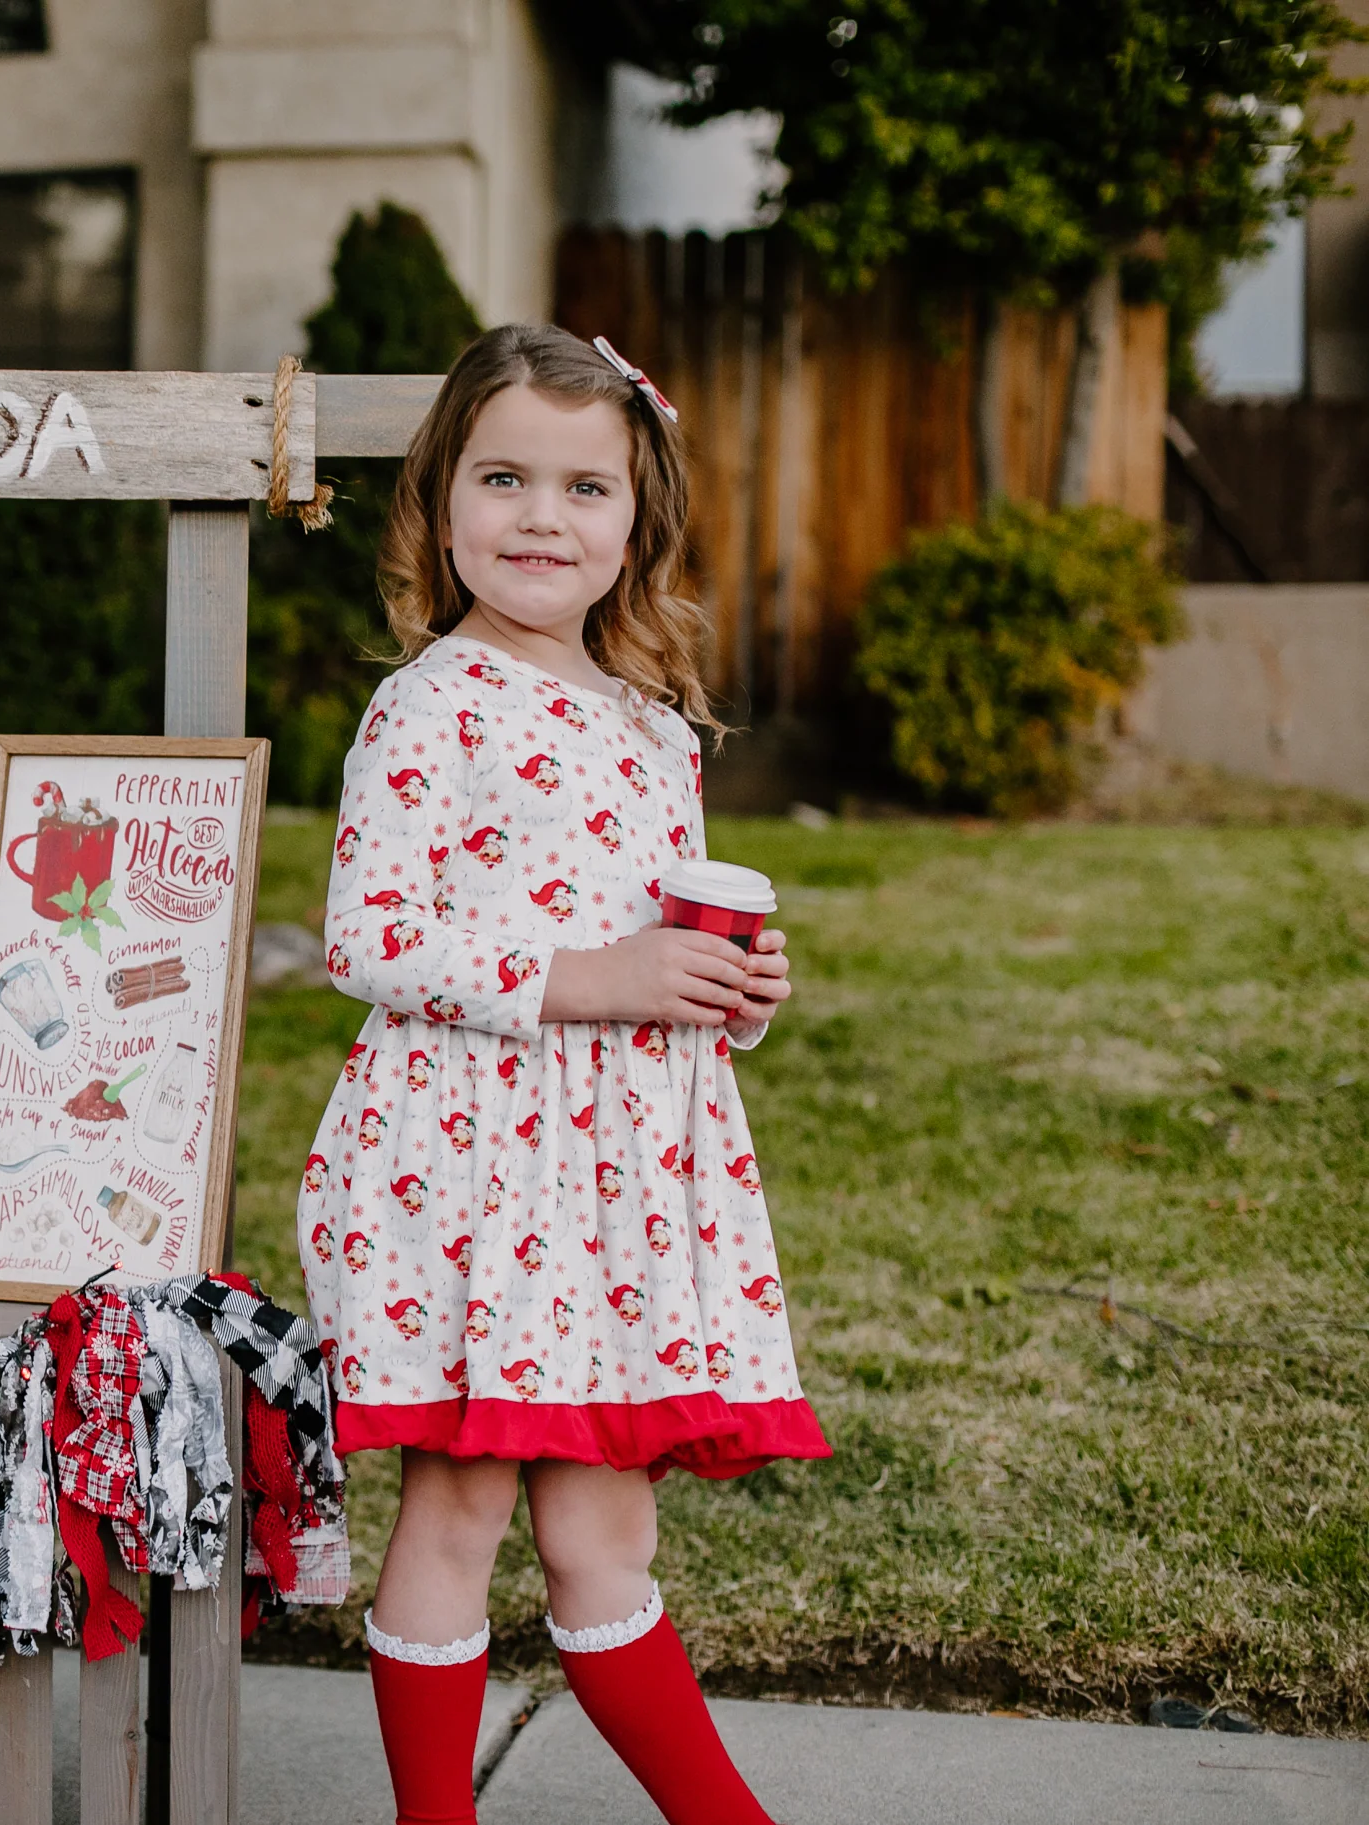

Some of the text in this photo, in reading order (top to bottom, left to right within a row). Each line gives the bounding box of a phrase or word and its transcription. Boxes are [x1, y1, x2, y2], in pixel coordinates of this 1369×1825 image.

[115, 773, 242, 807] PEPPERMINT
[124, 816, 184, 878] Hot
[193, 824, 219, 844] BEST
[128, 872, 223, 919] WITH MARSHMALLOWS
[45, 937, 63, 960] of
[191, 1010, 199, 1024] 3
[95, 1032, 111, 1061] 1/3
[88, 1060, 121, 1076] powder
[203, 1038, 216, 1093] cups
[194, 1095, 211, 1116] of
[49, 1119, 62, 1139] of
[181, 1119, 203, 1166] milk
[127, 1165, 184, 1212] VANILLA
[157, 1215, 188, 1271] EXTRACT
